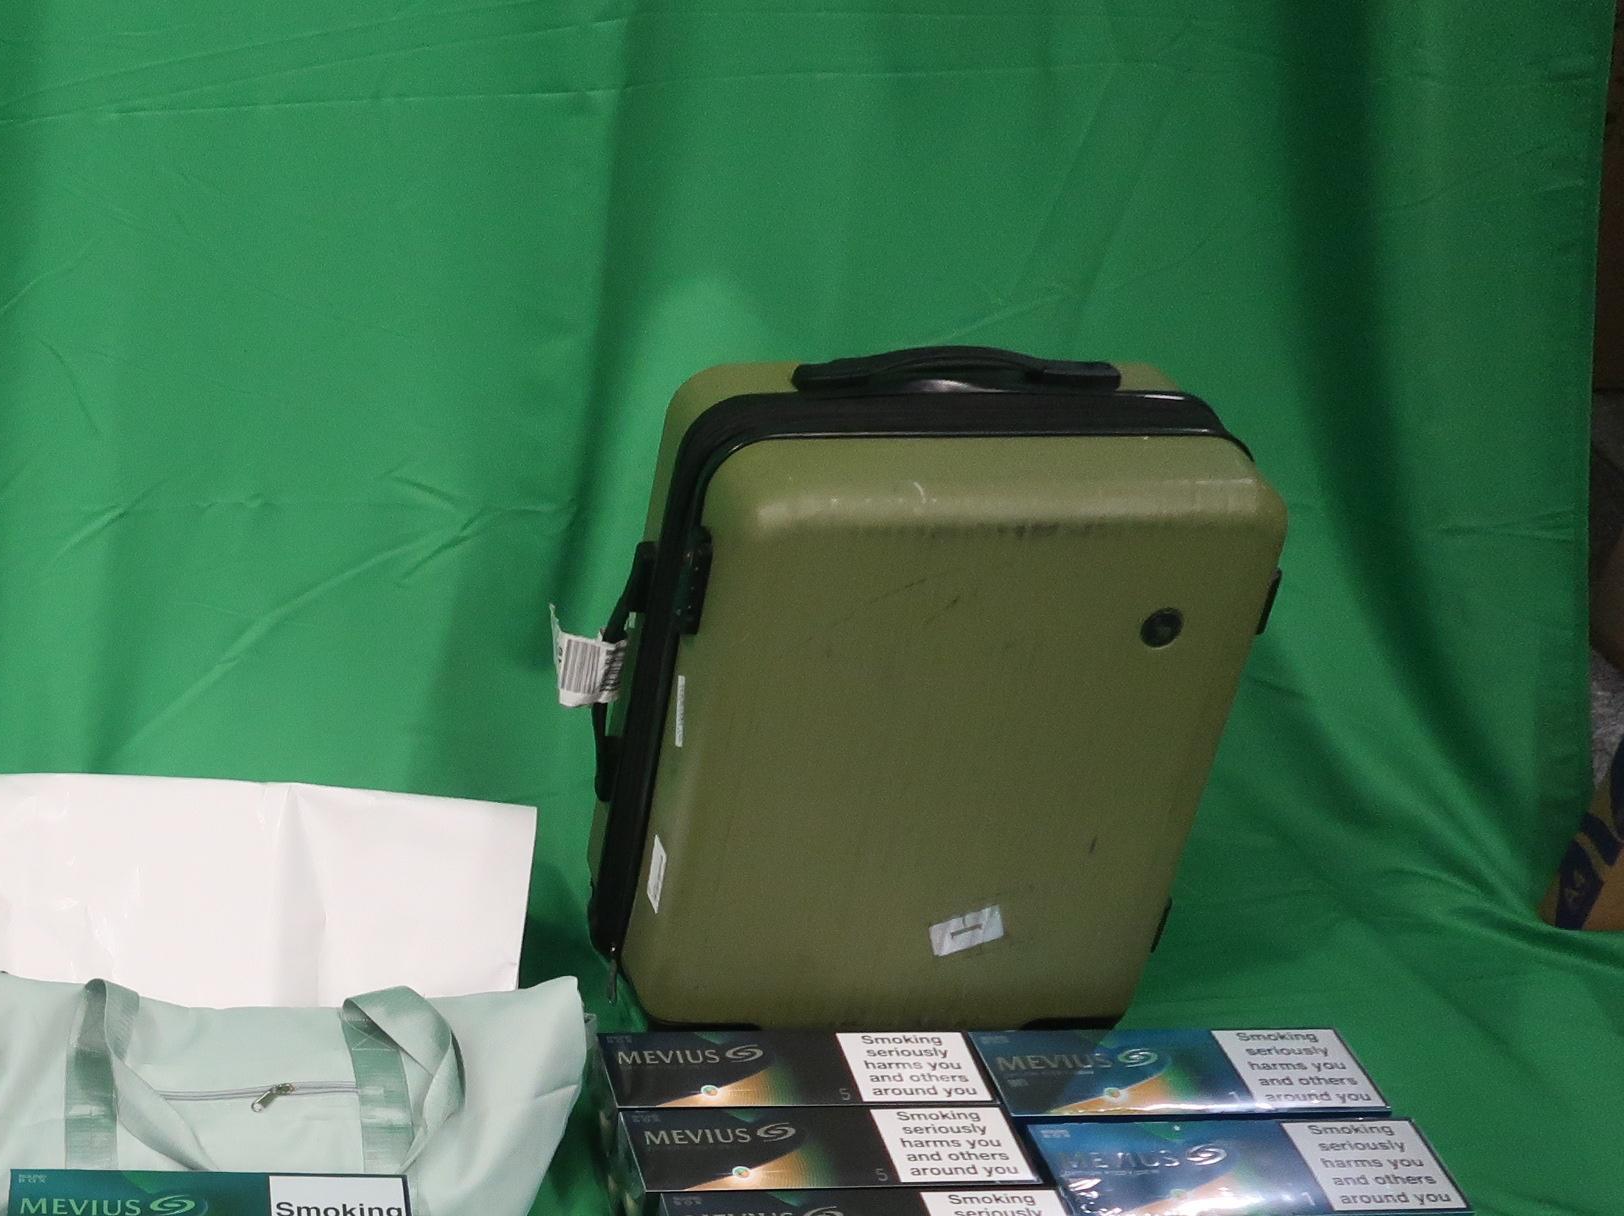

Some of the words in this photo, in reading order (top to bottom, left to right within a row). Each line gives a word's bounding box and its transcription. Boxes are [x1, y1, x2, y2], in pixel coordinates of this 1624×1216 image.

[617, 1048, 720, 1064] MEVIUS
[895, 1109, 982, 1123] Smoking
[901, 1122, 987, 1136] seriously
[1308, 1123, 1395, 1136] Smoking
[644, 1128, 750, 1145] MEVIUS
[898, 1137, 962, 1149] harms
[965, 1138, 1003, 1150] you
[1319, 1139, 1405, 1152] seriously
[905, 1150, 944, 1162] and
[947, 1150, 1010, 1162] others
[909, 1163, 979, 1177] around
[981, 1165, 1020, 1178] you
[1321, 1157, 1383, 1168] harms
[1387, 1158, 1424, 1170] you
[1333, 1174, 1370, 1185] and
[1373, 1173, 1437, 1185] others
[1341, 1191, 1410, 1204] around
[1414, 1193, 1452, 1206] you
[20, 1198, 142, 1216] MEVIUS
